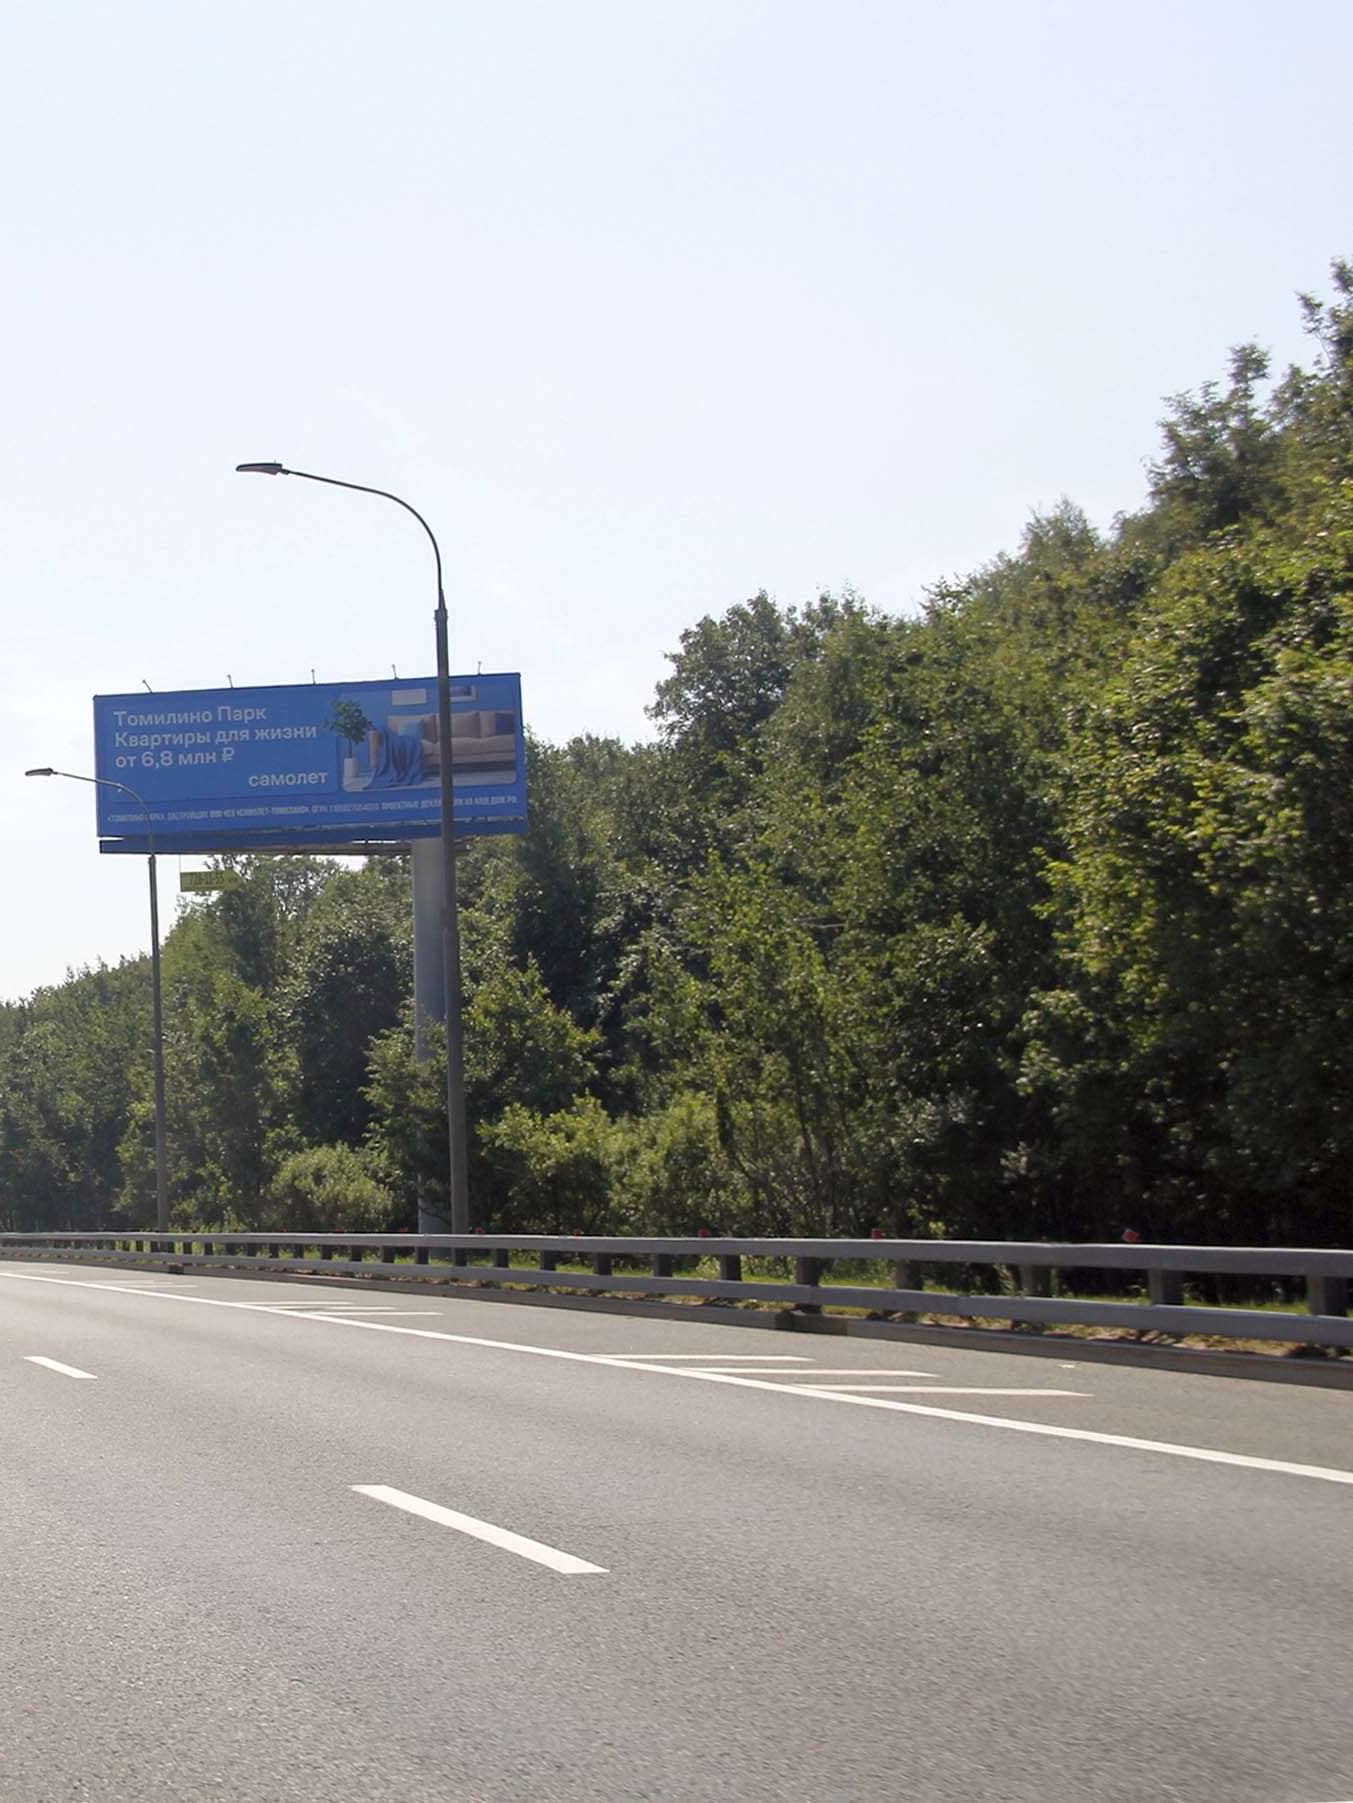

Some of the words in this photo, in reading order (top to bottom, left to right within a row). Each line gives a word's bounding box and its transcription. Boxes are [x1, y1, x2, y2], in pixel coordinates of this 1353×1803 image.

[112, 709, 213, 727] Томилино
[217, 705, 267, 724] Парк
[114, 731, 211, 750] Квартиры
[215, 729, 250, 745] для
[255, 725, 317, 741] жизни
[115, 755, 136, 768] от
[141, 750, 174, 768] 6,8
[178, 751, 217, 766] млн
[248, 771, 328, 787] самолет
